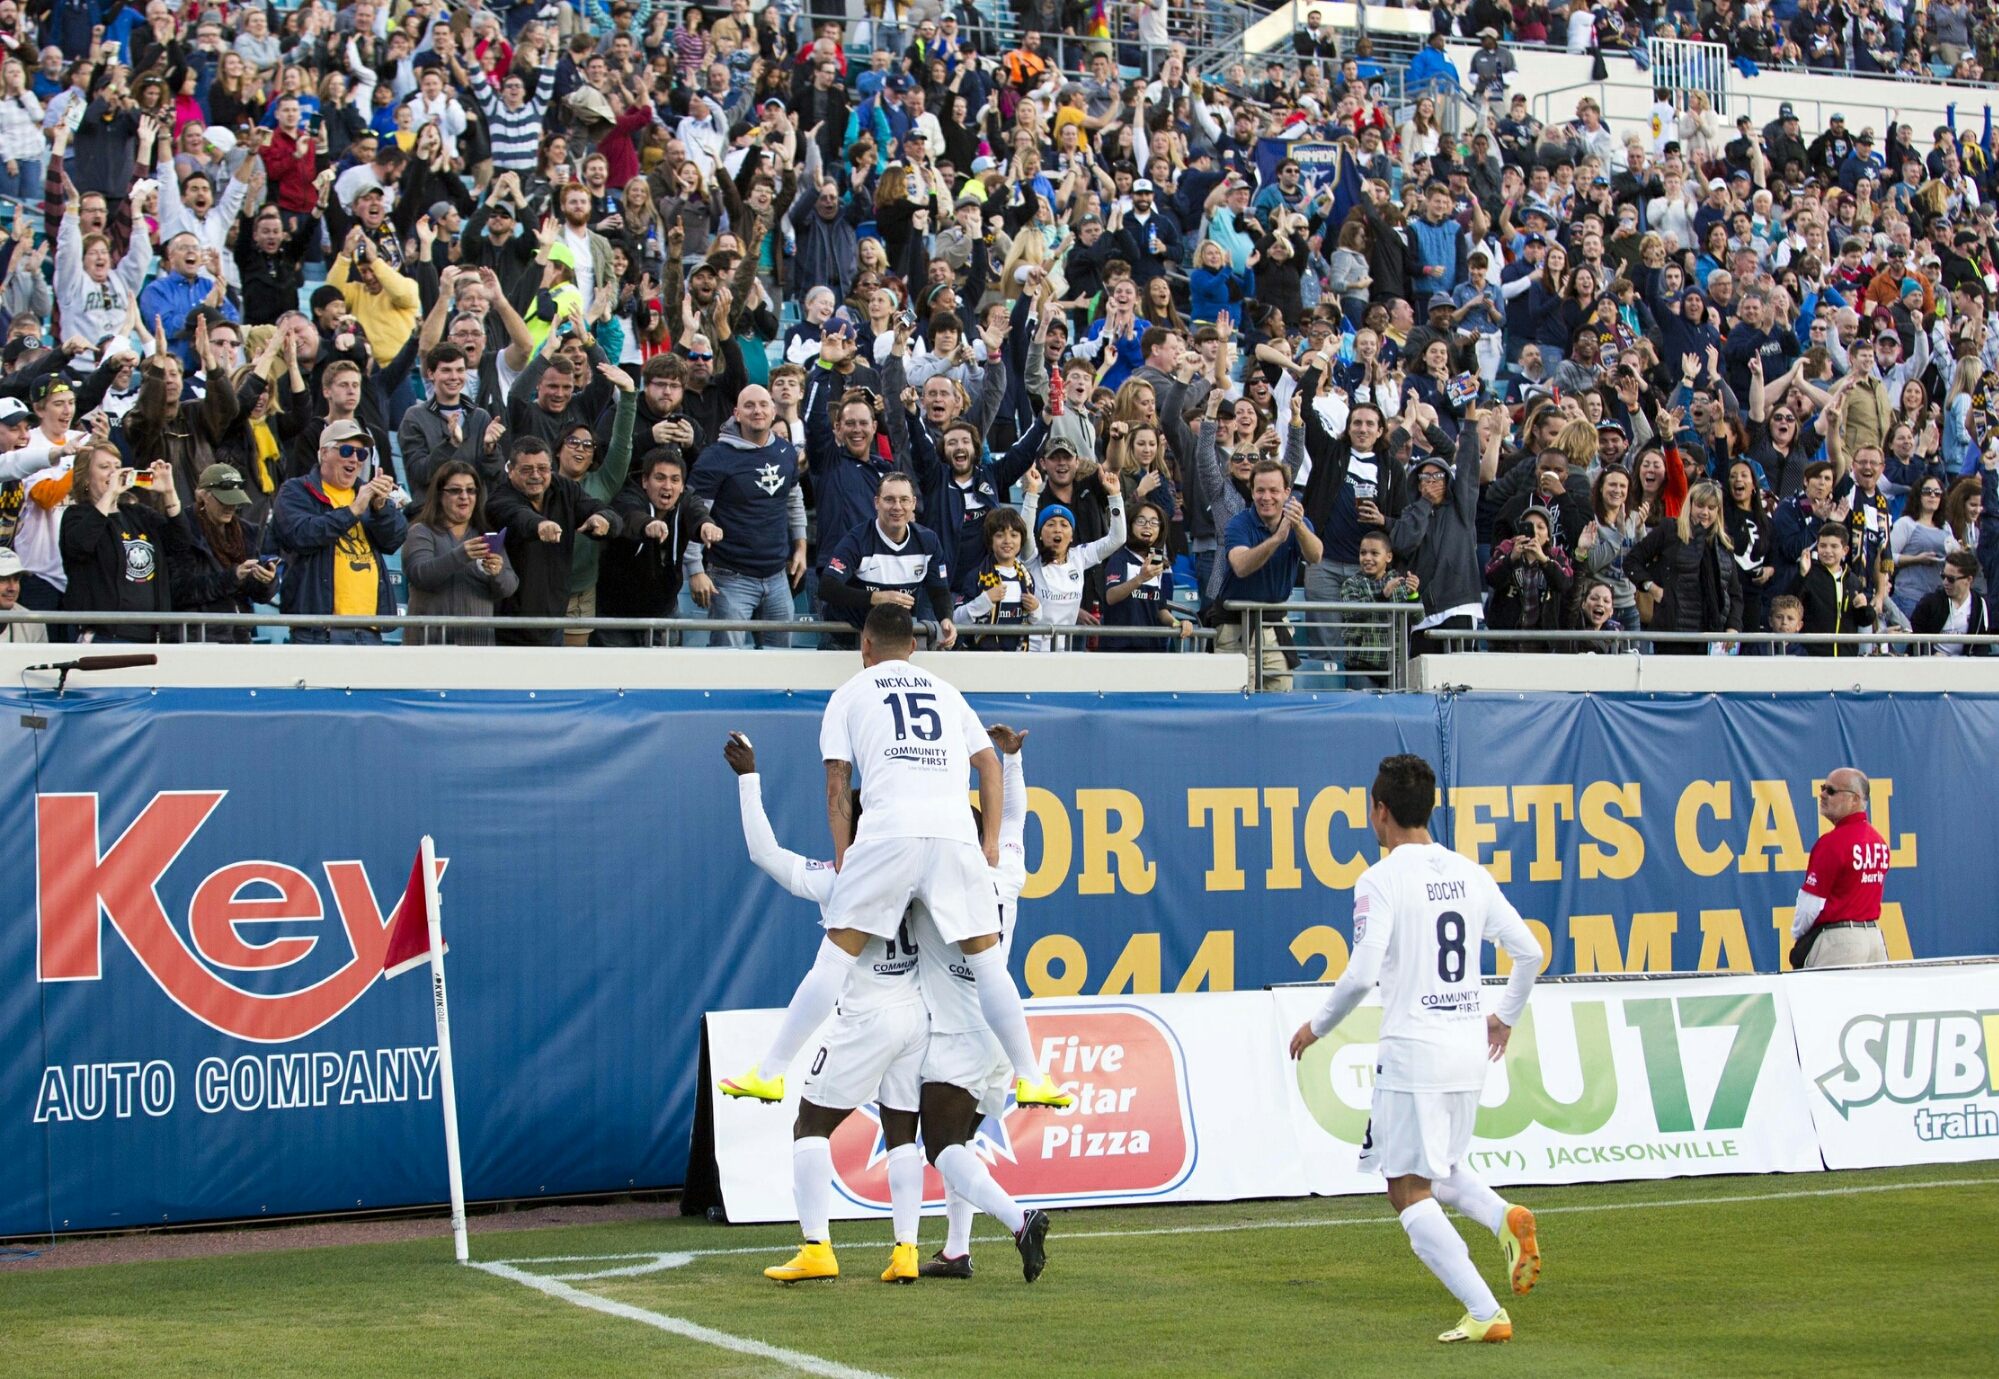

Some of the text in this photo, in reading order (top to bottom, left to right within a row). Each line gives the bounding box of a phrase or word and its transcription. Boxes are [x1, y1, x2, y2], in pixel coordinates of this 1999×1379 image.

[1293, 150, 1337, 164] ARMADA
[874, 677, 933, 689] NICKLAW
[883, 692, 942, 742] 15
[883, 746, 947, 757] COMMUNITY
[921, 757, 948, 766] FIRST
[969, 778, 1917, 898] OR TICETS CAL
[1426, 880, 1466, 901] BOCHY
[35, 790, 450, 1043] Key
[1436, 910, 1466, 983] 8
[1421, 990, 1479, 1006] COMMUNITY
[1459, 1001, 1481, 1014] FIRST
[1039, 1035, 1124, 1073] Five
[1814, 1009, 1999, 1121] SUB
[33, 1059, 175, 1122] AUTO
[195, 1046, 440, 1113] COMPANY
[1055, 1081, 1137, 1116] Star
[1041, 1124, 1151, 1159] Pizza
[1468, 1139, 1739, 1172] (TV) JACKSONVILLE
